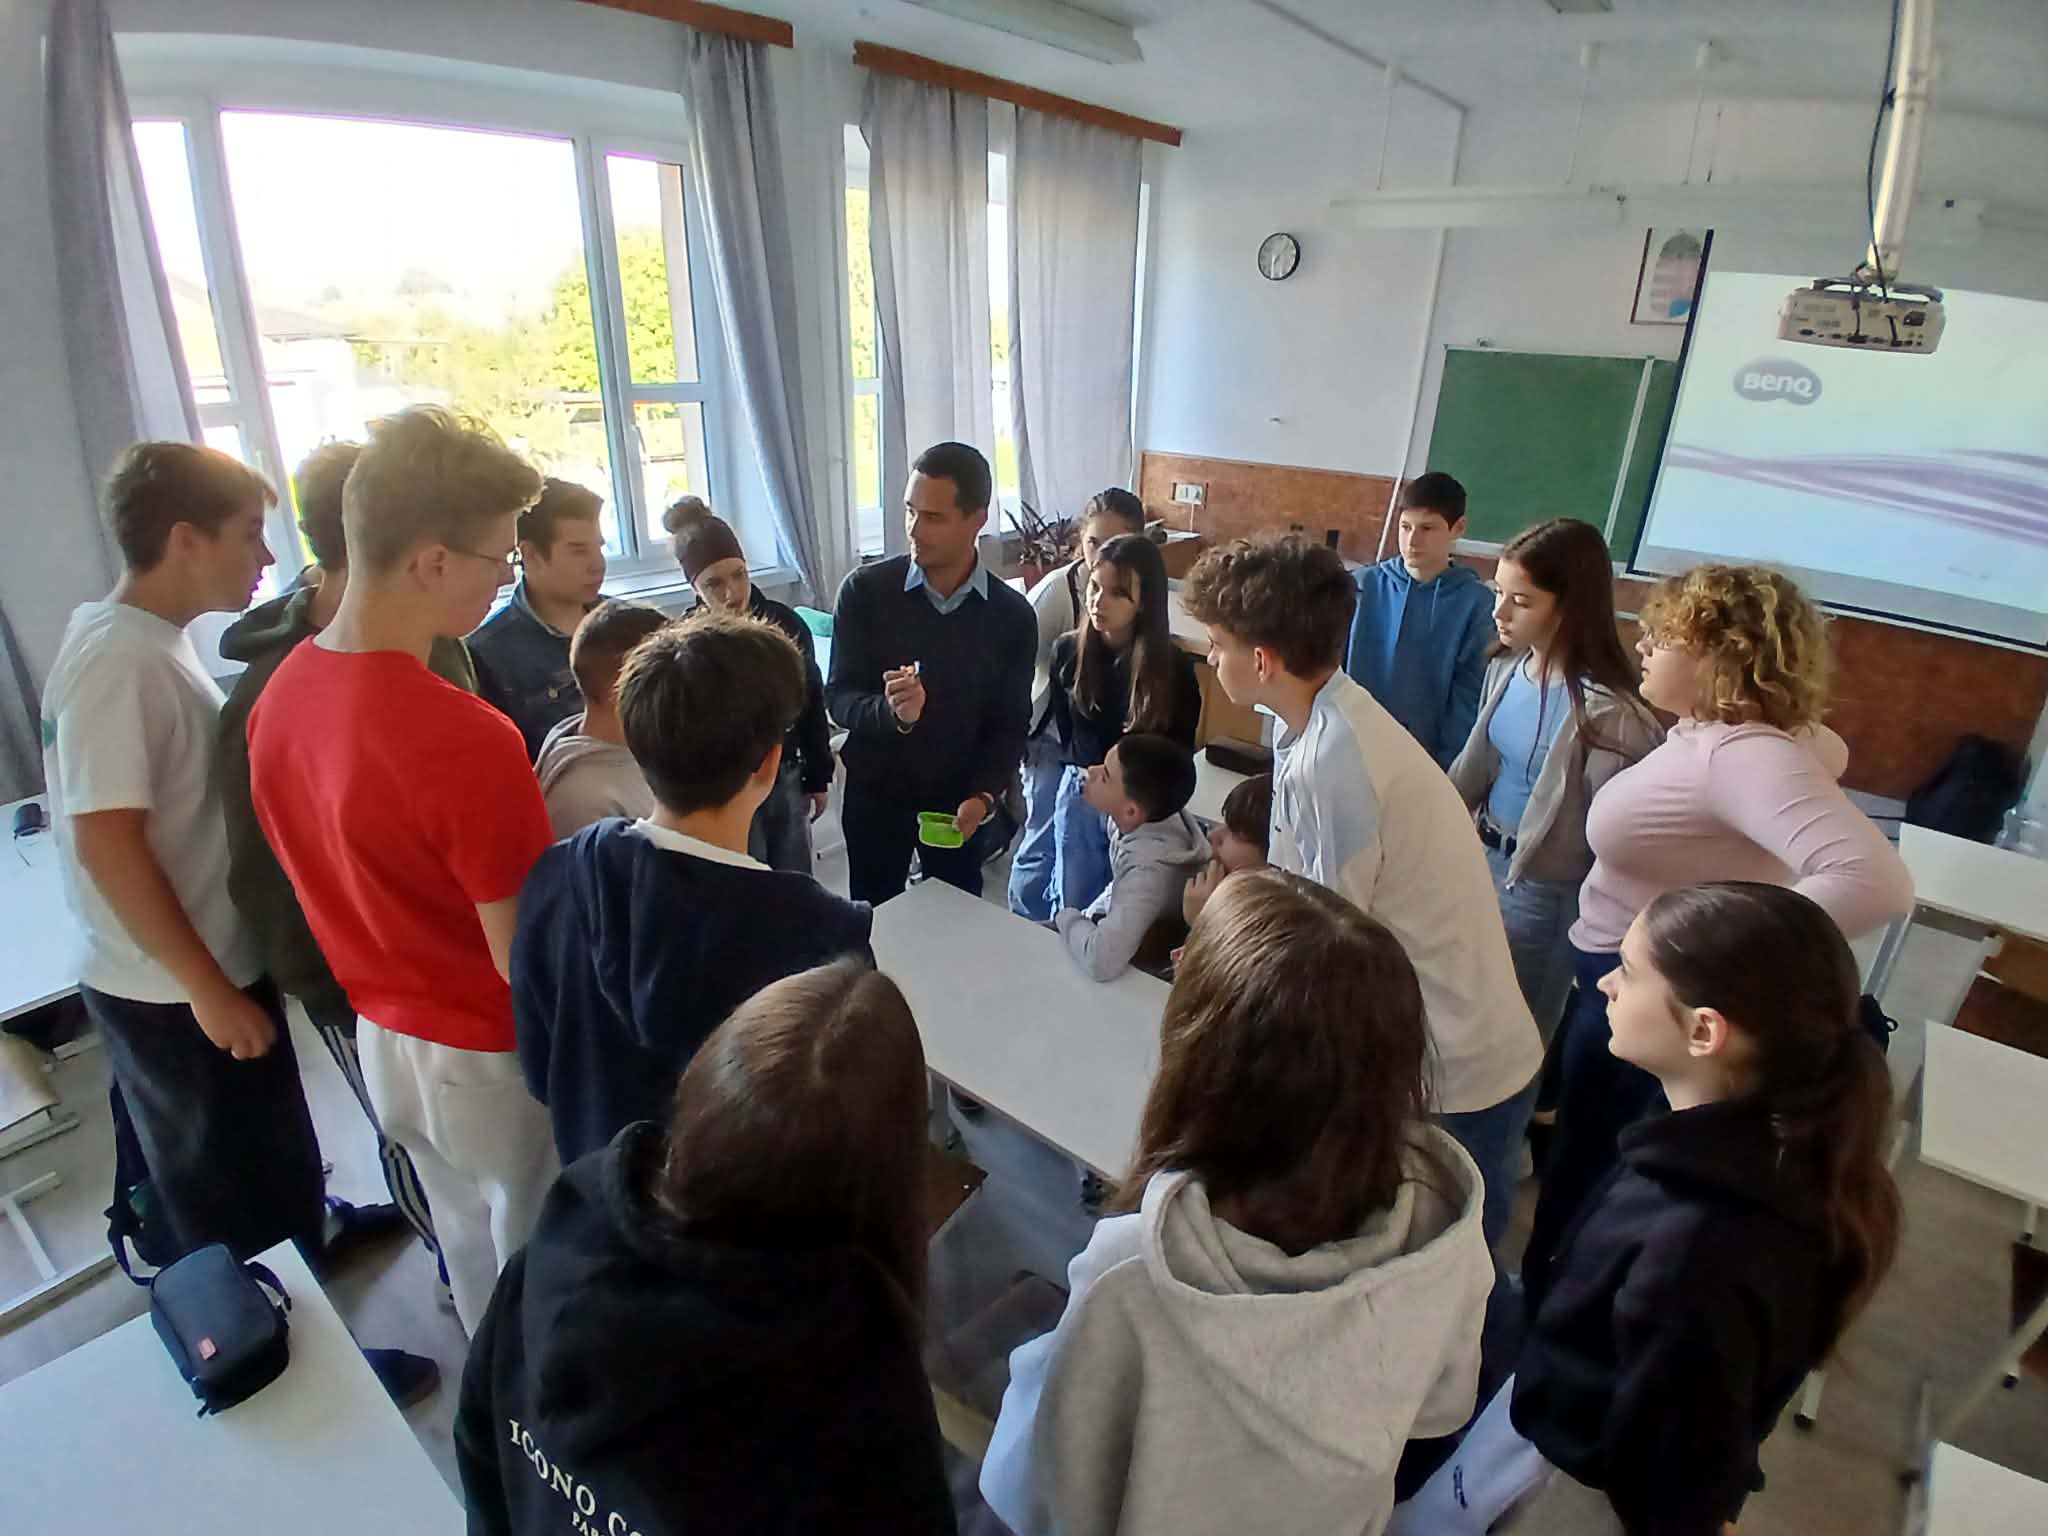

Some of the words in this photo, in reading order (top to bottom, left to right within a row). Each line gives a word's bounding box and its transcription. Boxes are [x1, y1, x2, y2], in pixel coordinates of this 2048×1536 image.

[1743, 372, 1814, 398] BenQ
[509, 1418, 597, 1516] ICONO
[608, 1511, 642, 1536] C
